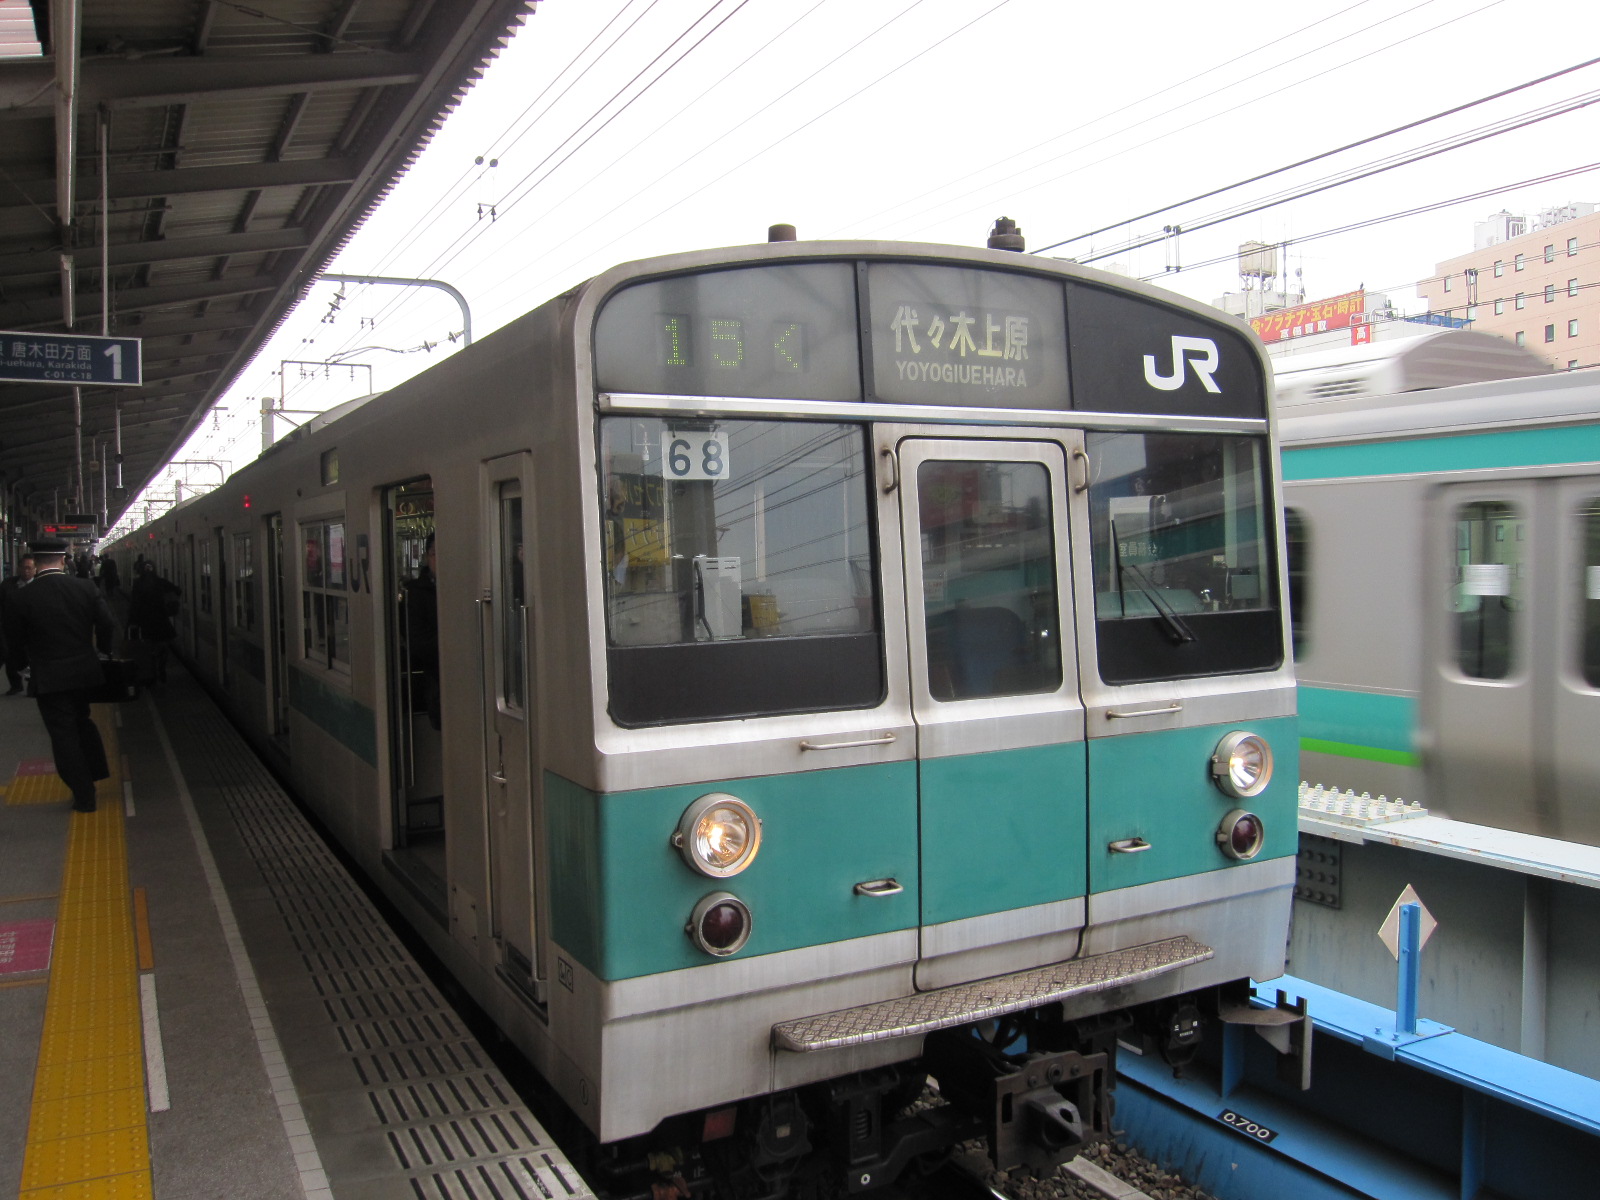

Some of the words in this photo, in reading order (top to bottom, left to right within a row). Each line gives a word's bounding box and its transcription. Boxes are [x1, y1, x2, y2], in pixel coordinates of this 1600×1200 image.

[12, 341, 91, 361] 唐木田方面
[891, 305, 1029, 361] 代々木上原
[48, 360, 92, 370] Karakida
[104, 344, 122, 380] 1
[896, 360, 1028, 388] YOYOGIUEHARA
[1143, 335, 1222, 394] JR
[669, 439, 723, 476] 68
[350, 534, 371, 594] JR
[1223, 1112, 1270, 1138] 0.700
